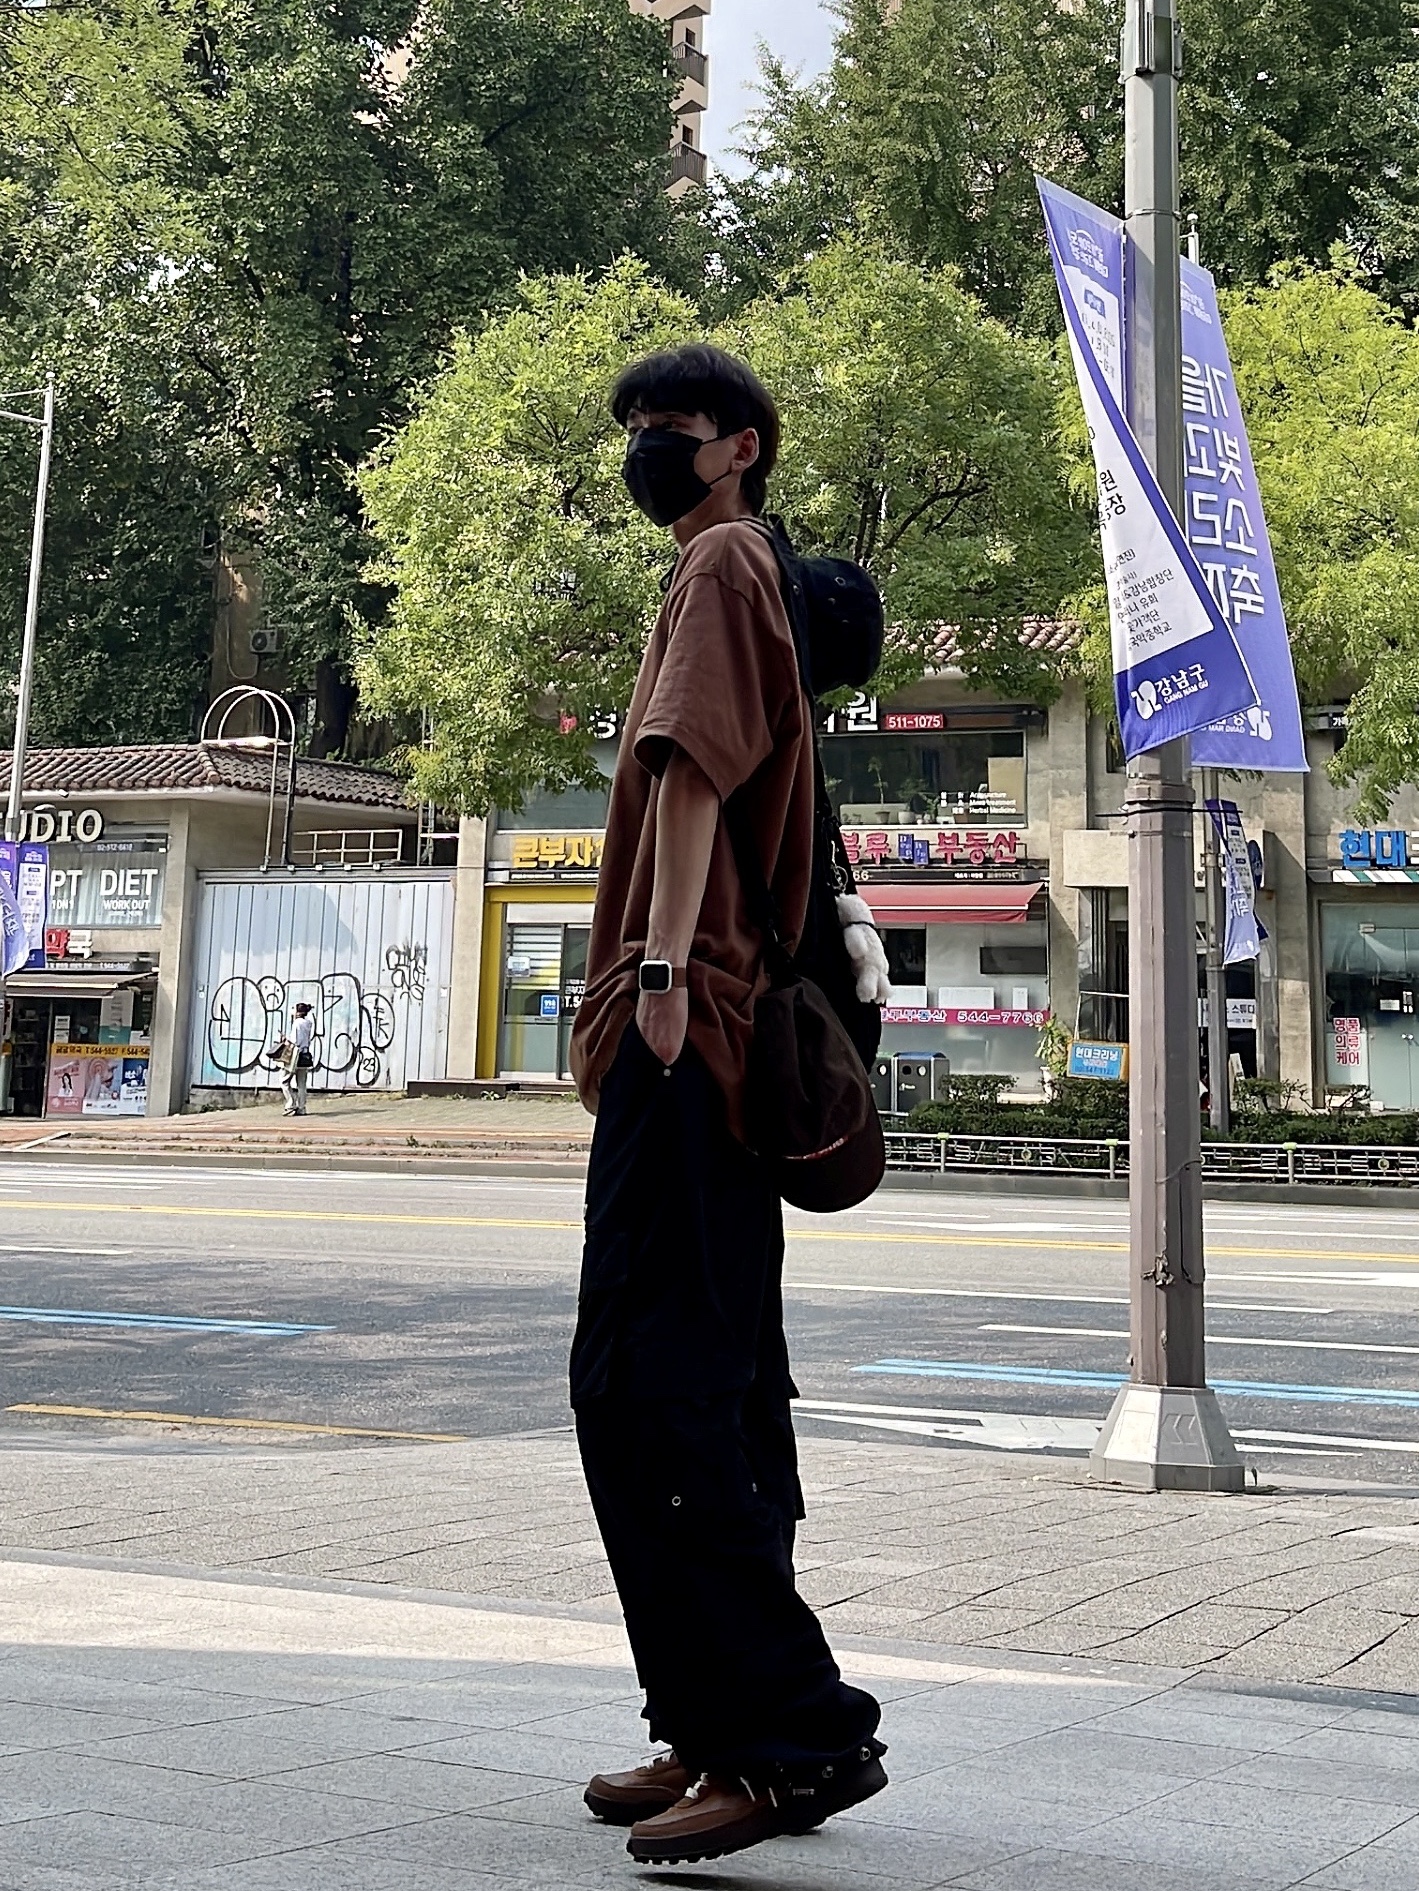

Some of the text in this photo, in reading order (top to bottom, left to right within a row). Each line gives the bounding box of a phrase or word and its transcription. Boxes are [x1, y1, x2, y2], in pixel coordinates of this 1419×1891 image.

[1098, 469, 1118, 495] 원
[1155, 663, 1205, 697] 강남구
[1163, 680, 1209, 704] GANG NAM GU
[888, 715, 941, 729] 511-1075
[841, 831, 1020, 865] 블루 부동산
[50, 868, 159, 896] PT DIET
[103, 899, 131, 910] WORK
[133, 899, 150, 910] OUT
[957, 1010, 1045, 1024] 544-7766
[1334, 1018, 1360, 1033] 명품
[1335, 1035, 1360, 1049] 의류
[362, 1057, 376, 1072] 23
[1336, 1051, 1361, 1066] 케어
